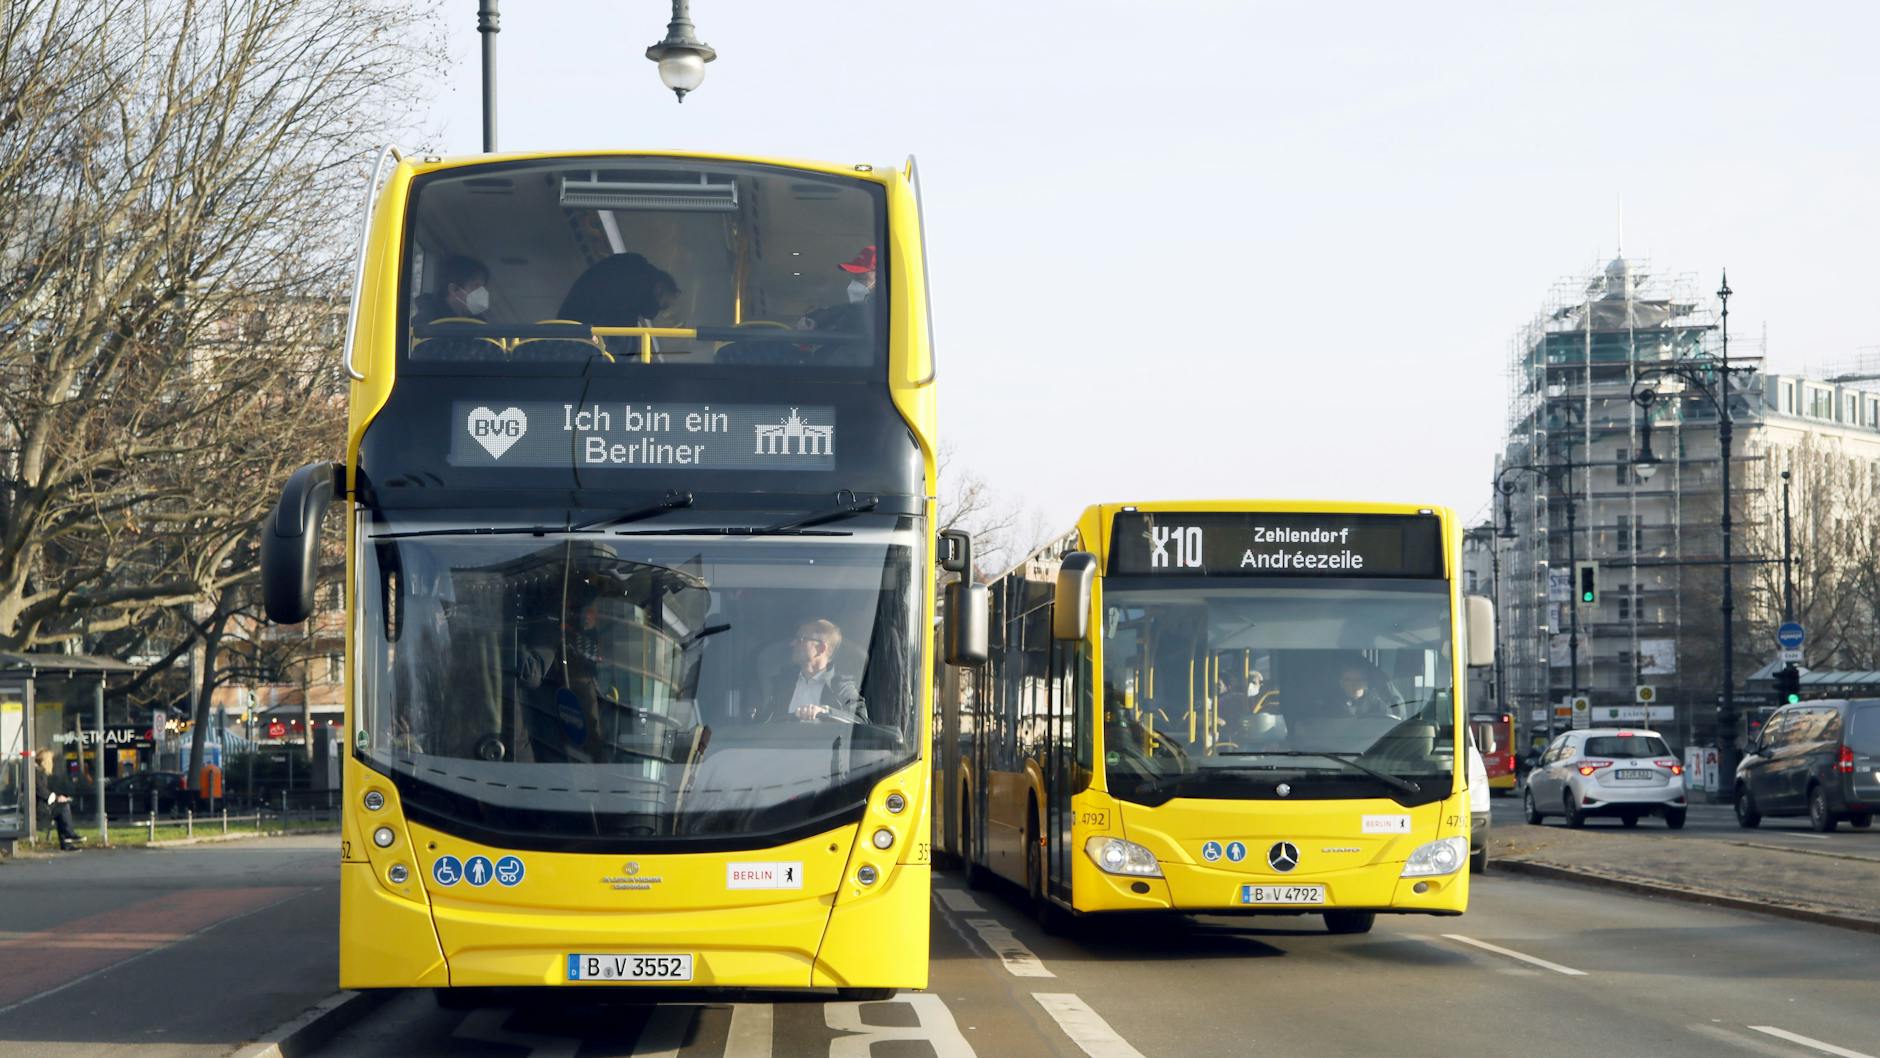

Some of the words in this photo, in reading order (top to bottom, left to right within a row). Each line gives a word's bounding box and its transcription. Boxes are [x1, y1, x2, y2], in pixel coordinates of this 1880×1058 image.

[475, 419, 520, 437] BVG
[563, 404, 610, 431] Ich
[625, 405, 670, 432] bin
[685, 405, 728, 433] ein
[585, 436, 705, 465] Berliner
[1254, 526, 1349, 544] Zehlendorf
[1151, 526, 1203, 568] X10
[1240, 548, 1364, 569] Andréezeile
[1081, 812, 1105, 826] 4792
[733, 870, 773, 881] BERLIN
[1254, 887, 1265, 901] B
[1272, 887, 1282, 901] V
[1285, 887, 1318, 901] 4792
[587, 957, 600, 976] B
[615, 957, 627, 977] V
[632, 957, 682, 977] 3552
